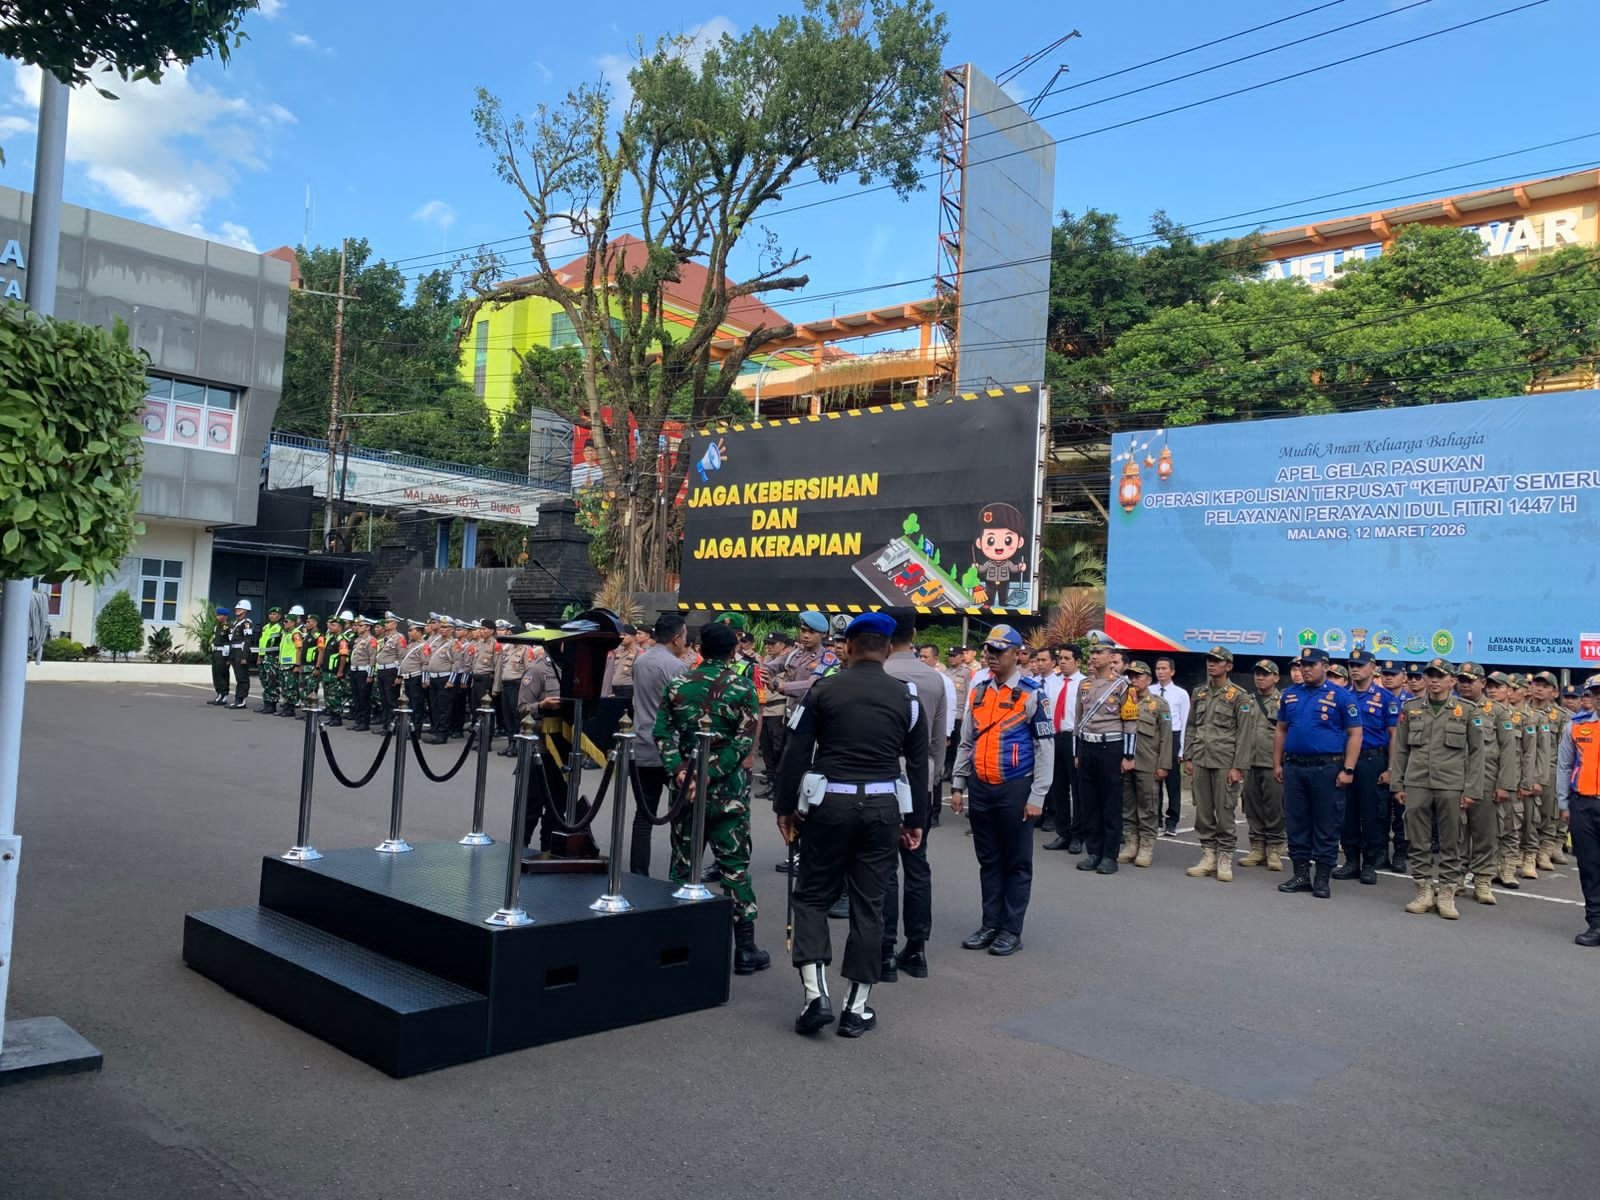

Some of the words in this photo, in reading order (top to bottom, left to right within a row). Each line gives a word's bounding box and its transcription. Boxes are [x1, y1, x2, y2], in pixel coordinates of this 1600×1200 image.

[1279, 443, 1320, 458] Mudik
[1320, 441, 1360, 457] Aman
[1361, 437, 1423, 455] Keluarga
[1426, 432, 1486, 450] Bahagia
[1276, 467, 1322, 482] APEL
[1325, 462, 1386, 479] GELAR
[1390, 455, 1484, 475] PASUKAN
[404, 489, 450, 505] MALANG
[455, 495, 480, 510] KOTA
[490, 501, 521, 515] BUNGA
[688, 485, 740, 508] JAGA
[743, 472, 879, 504] KEBERSIHAN
[1143, 491, 1209, 508] OPERASI
[1212, 487, 1308, 506] KEPOLISIAN
[1312, 482, 1407, 502] TERPUSAT
[1411, 476, 1510, 496] “KETUPAT
[1515, 471, 1600, 490] SEMERU
[751, 507, 798, 531] DAN
[1205, 507, 1301, 525] PELAYANAN
[1305, 503, 1400, 522] PERAYAAN
[1404, 502, 1449, 518] IDUL
[1453, 499, 1502, 516] FITRI
[1508, 497, 1553, 514] 1447
[1559, 495, 1576, 512] H
[1287, 527, 1350, 540] MALANG,
[1355, 526, 1370, 539] 12
[1374, 524, 1430, 538] MARET
[1431, 523, 1466, 537] 2026
[693, 537, 748, 559] JAGA
[751, 532, 862, 558] KERAPIAN
[1182, 628, 1267, 645] PRESISI
[1487, 644, 1513, 652] BEBAS
[1515, 645, 1541, 653] PULSA
[1546, 646, 1556, 654] 24
[1557, 646, 1575, 654] JAM
[1489, 636, 1524, 644] LAYANAN
[1525, 638, 1573, 646] KEPOLISIAN
